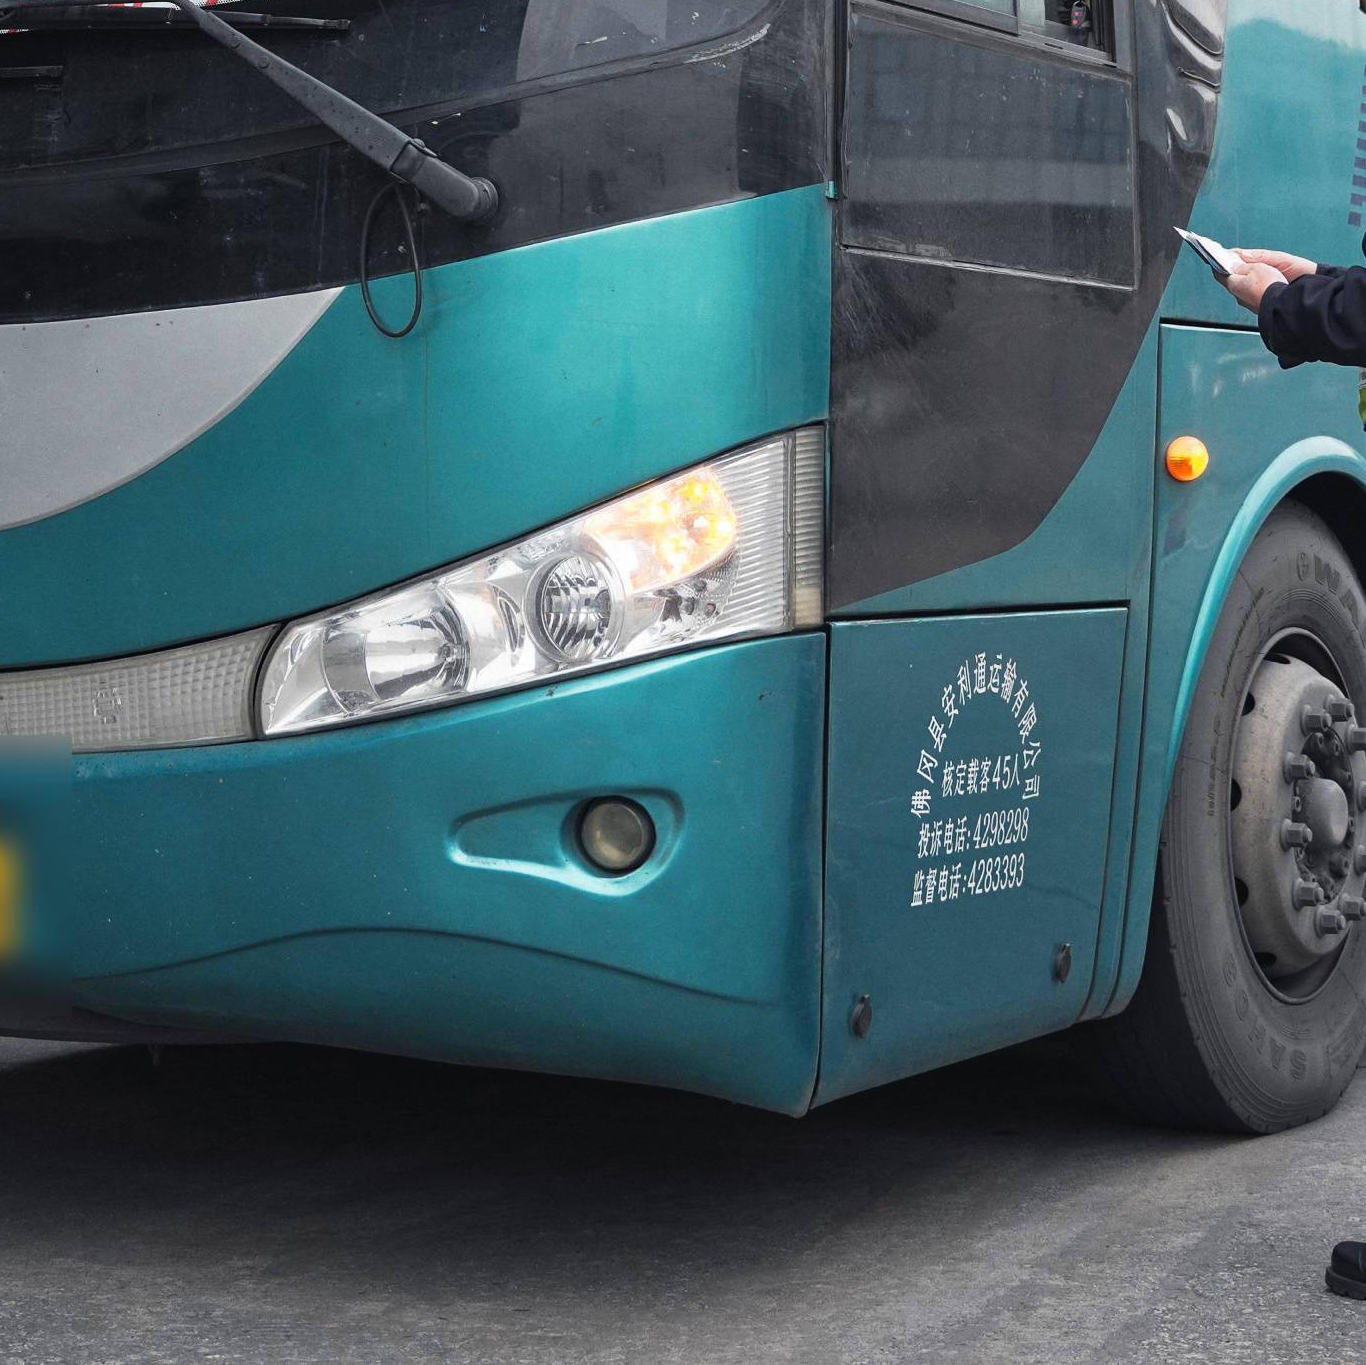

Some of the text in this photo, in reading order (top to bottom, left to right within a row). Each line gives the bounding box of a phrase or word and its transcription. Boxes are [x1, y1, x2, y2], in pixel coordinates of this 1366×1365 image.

[941, 753, 1020, 797] 核定载客45人
